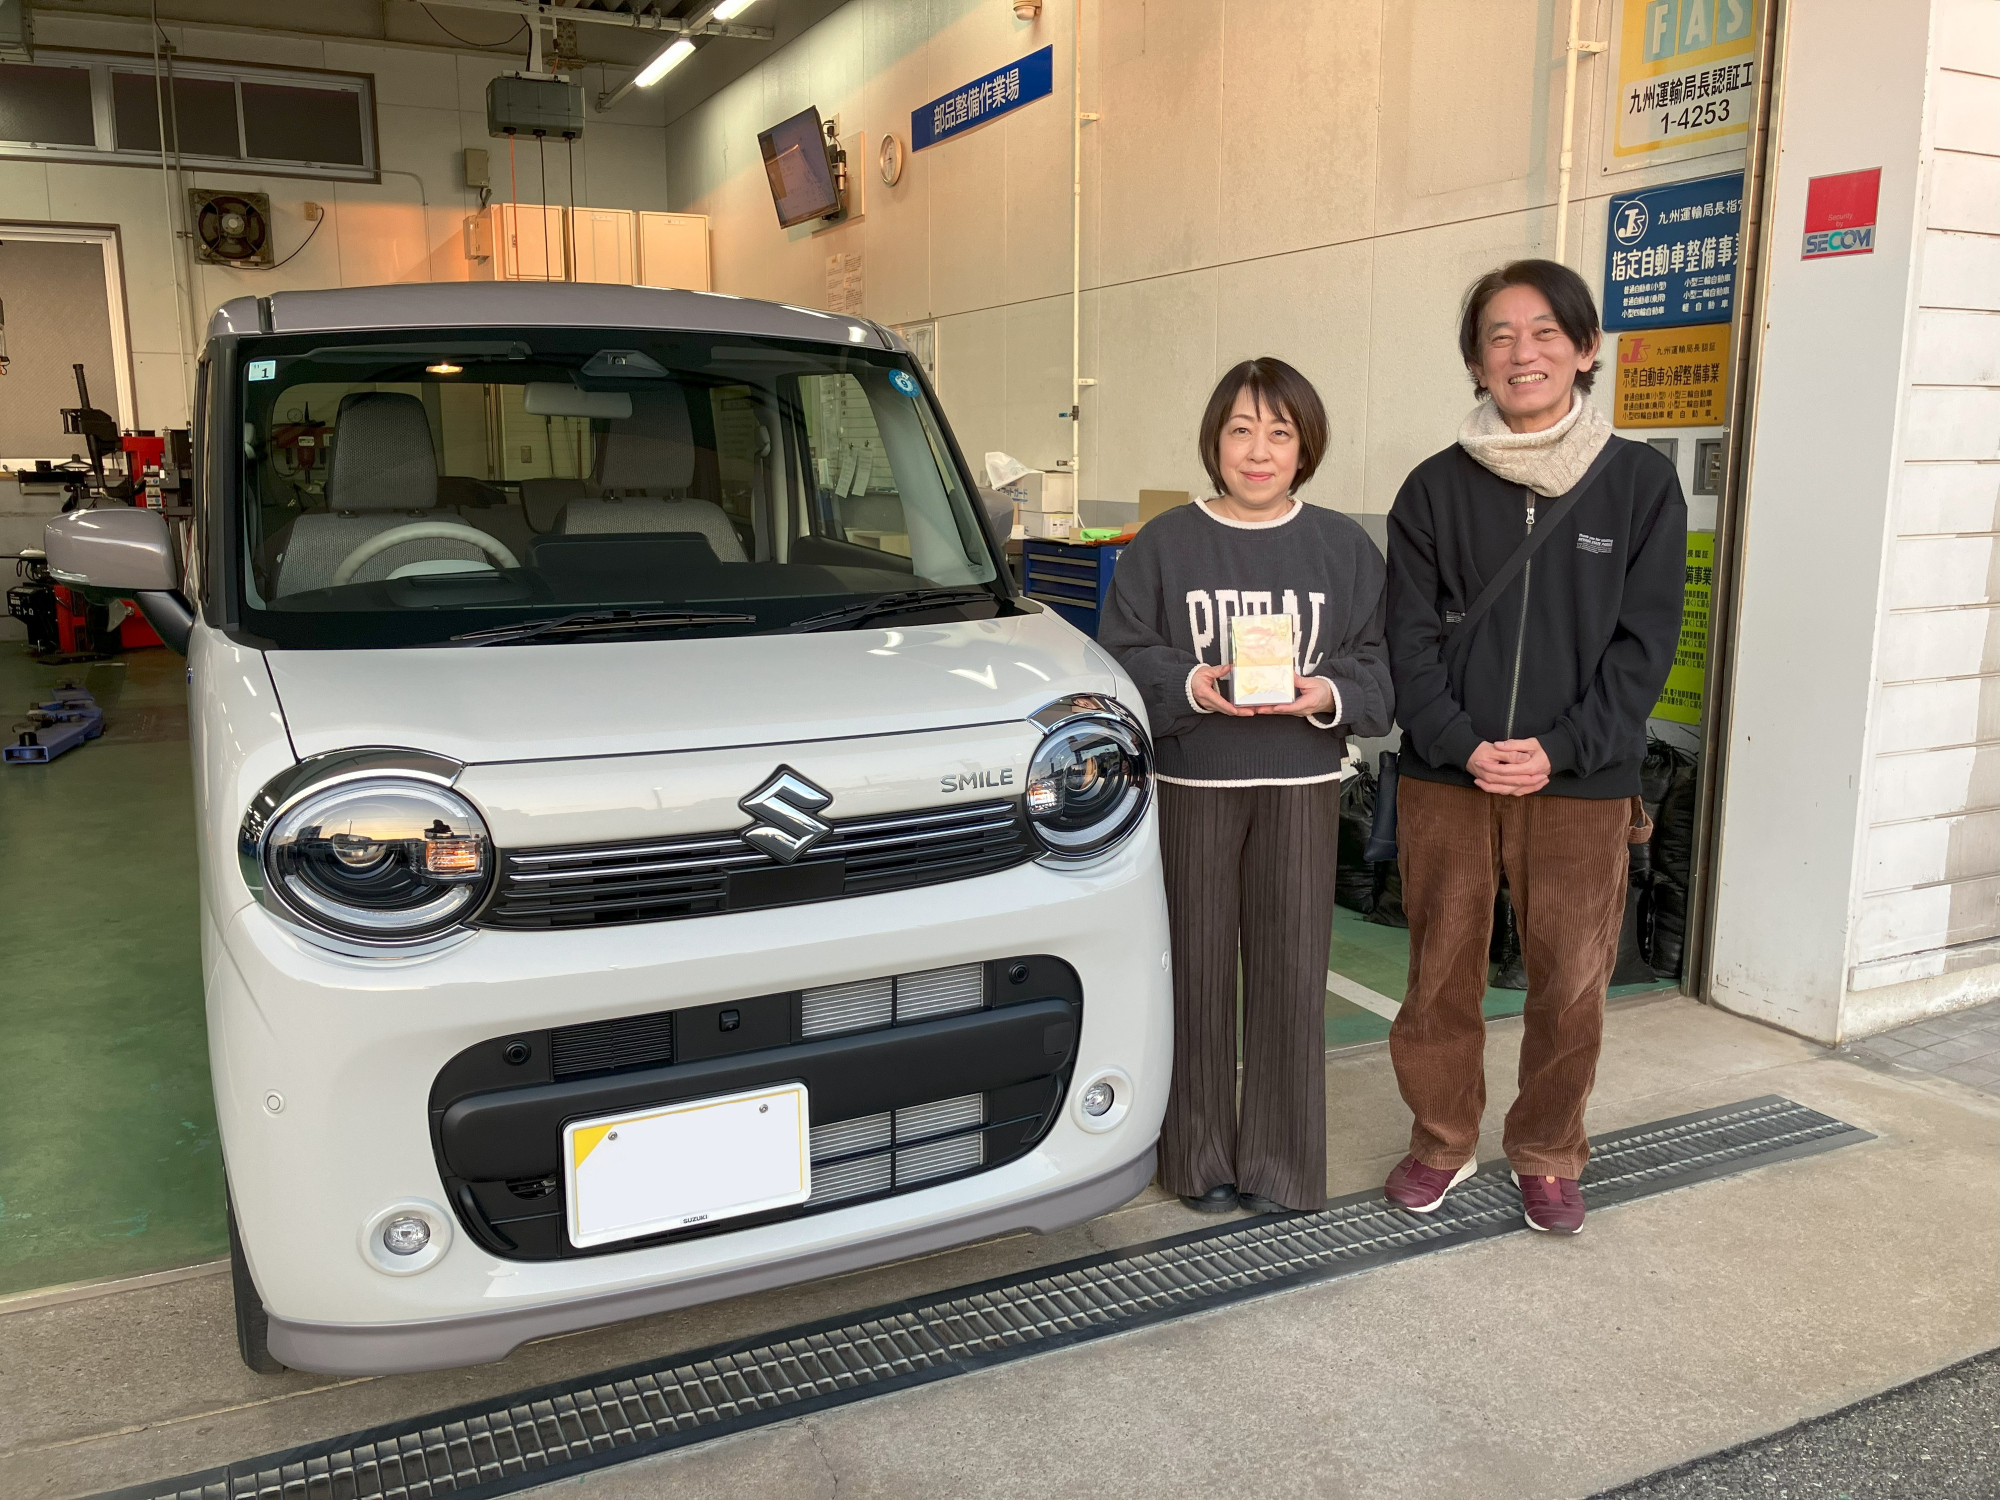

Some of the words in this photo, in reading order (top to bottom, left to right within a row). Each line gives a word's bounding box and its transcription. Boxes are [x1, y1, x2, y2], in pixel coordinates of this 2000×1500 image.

[1629, 61, 1754, 115] 九州運輸局長認証工
[933, 67, 1020, 136] 部品整備作業場
[1660, 98, 1731, 135] 1-4253
[1828, 213, 1853, 222] Security
[1806, 228, 1872, 254] SECOM
[1656, 342, 1717, 356] 九州運輸局長認証
[261, 367, 270, 379] 1
[1639, 362, 1721, 388] 自動車分解整備事業
[940, 768, 1013, 793] SMILE
[682, 1214, 708, 1224] SUZUKI
